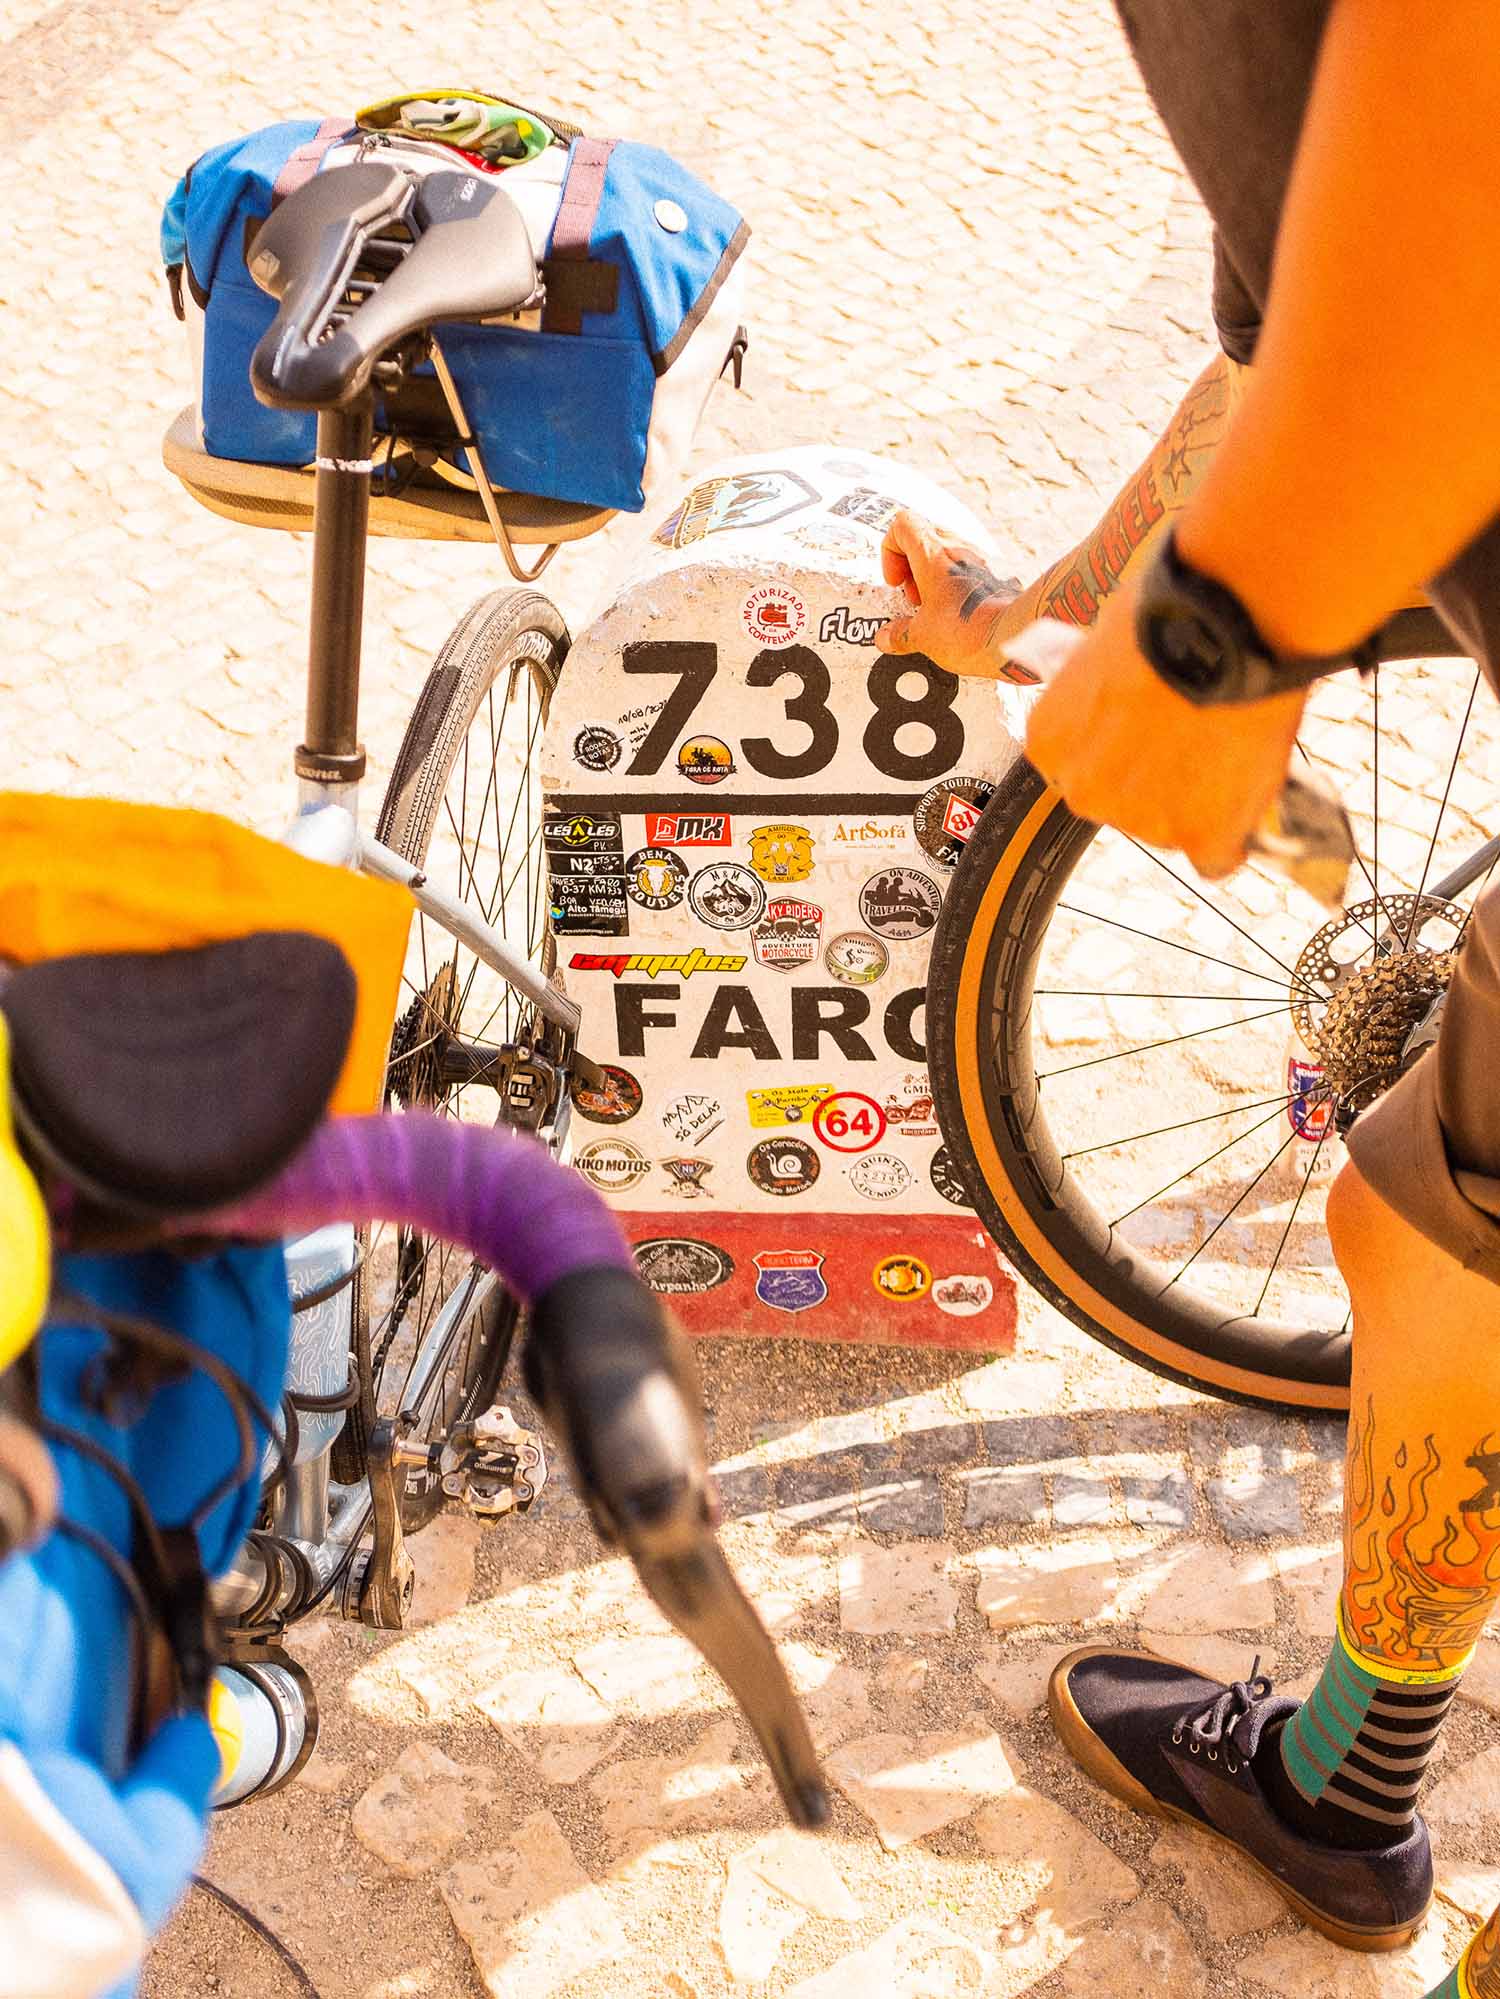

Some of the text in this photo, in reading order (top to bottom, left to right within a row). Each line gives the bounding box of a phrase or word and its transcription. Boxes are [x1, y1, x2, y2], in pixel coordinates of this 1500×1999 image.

[744, 588, 806, 627] MOTURIZADAS
[748, 626, 797, 645] CORTELHA
[622, 642, 964, 781] 738
[916, 787, 940, 832] SUPPORT
[942, 778, 971, 790] YOUR
[832, 821, 906, 841] ArtSofá
[951, 811, 975, 832] 81
[638, 850, 673, 860] BENA
[710, 870, 720, 881] M
[731, 870, 740, 881] M
[588, 884, 606, 895] KM
[628, 874, 686, 907] PROUDERS
[890, 870, 939, 912] ON ADVENTURE
[567, 905, 587, 913] Alto
[764, 904, 820, 920] AKY RIDERS
[762, 949, 814, 959] MOTORCYCLE
[689, 1101, 721, 1129] DELAS
[825, 1108, 873, 1137] 64
[573, 1157, 652, 1173] KIKO MOTOS
